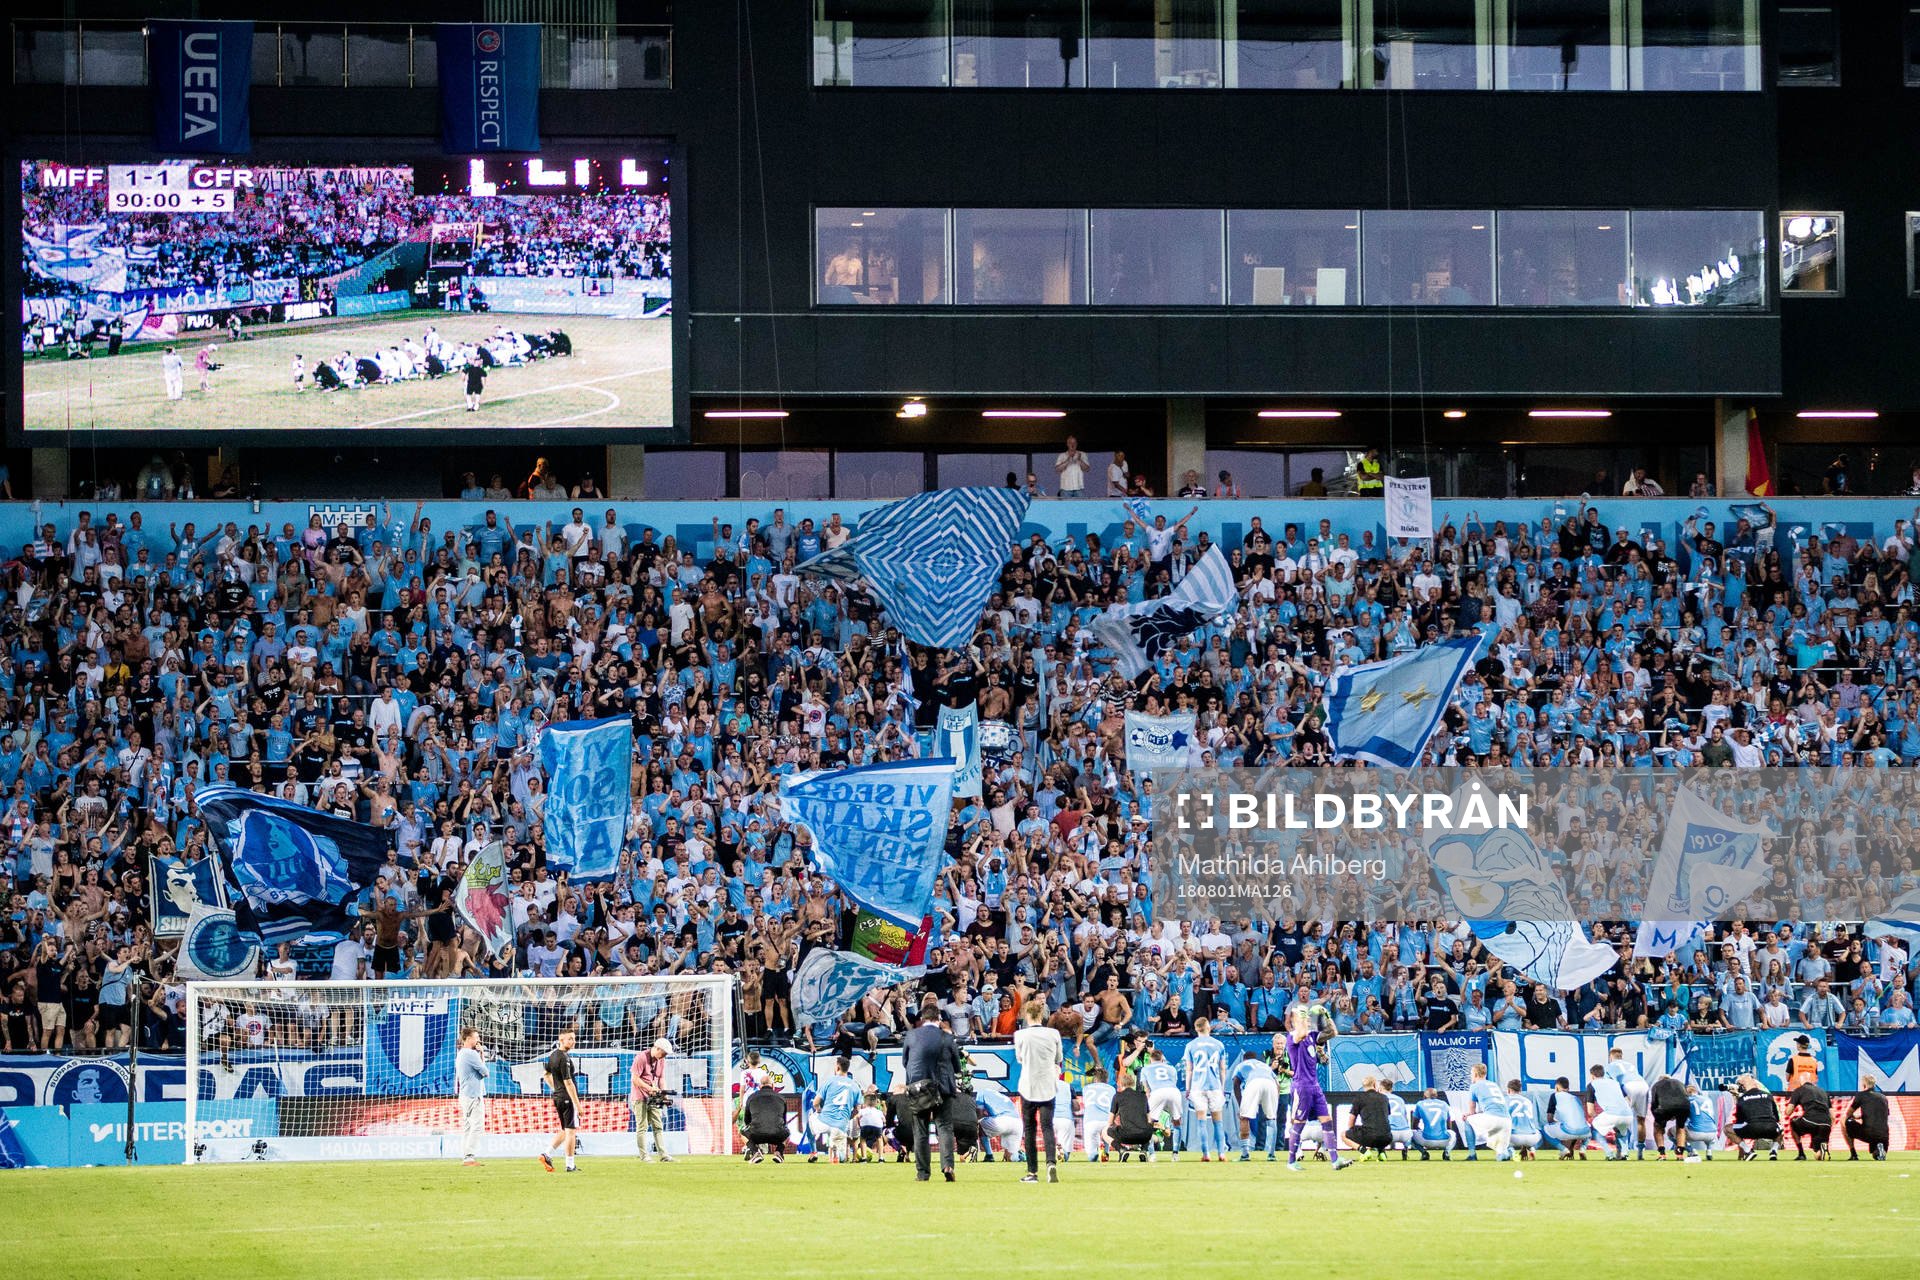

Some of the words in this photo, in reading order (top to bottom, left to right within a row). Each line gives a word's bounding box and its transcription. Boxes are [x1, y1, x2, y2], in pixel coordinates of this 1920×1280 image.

[184, 32, 217, 139] UEFA
[480, 60, 501, 147] RESPECT
[43, 168, 103, 187] MFF
[126, 170, 170, 186] 1-1
[193, 168, 254, 188] CFR
[115, 193, 180, 208] 90:00
[212, 193, 226, 208] 5
[1688, 834, 1728, 850] 1910
[1428, 1036, 1467, 1047] MALMÖ
[1469, 1036, 1482, 1046] FF
[1194, 1050, 1219, 1077] 24
[1154, 1067, 1170, 1082] 8
[832, 1090, 848, 1106] 4
[1085, 1089, 1110, 1107] 26
[1430, 1107, 1445, 1127] 7
[379, 1141, 436, 1156] PRISET
